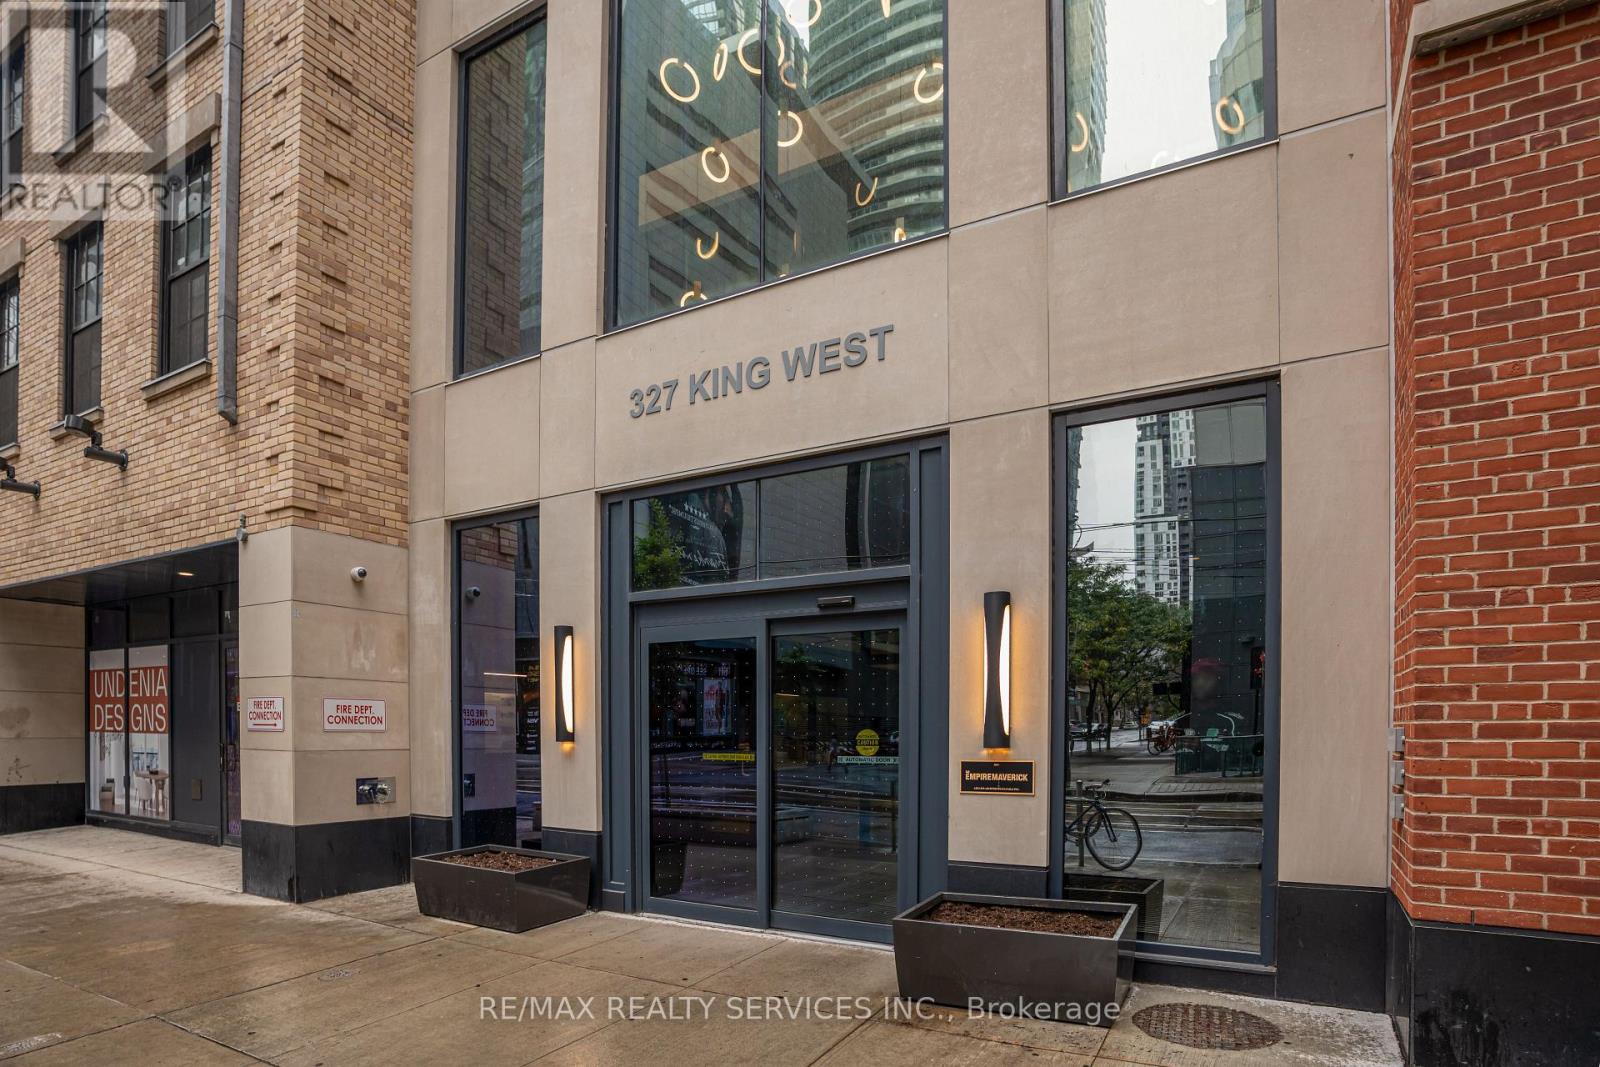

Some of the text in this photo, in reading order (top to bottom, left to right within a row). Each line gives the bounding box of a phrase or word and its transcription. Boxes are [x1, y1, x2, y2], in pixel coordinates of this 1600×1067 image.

[629, 324, 894, 418] 327 KING WEST
[253, 700, 263, 710] FIRE
[336, 704, 375, 715] FIRE DEPT.
[94, 703, 167, 732] DESGNS
[248, 711, 282, 721] CONNECTION
[327, 715, 383, 725] CONNECTION
